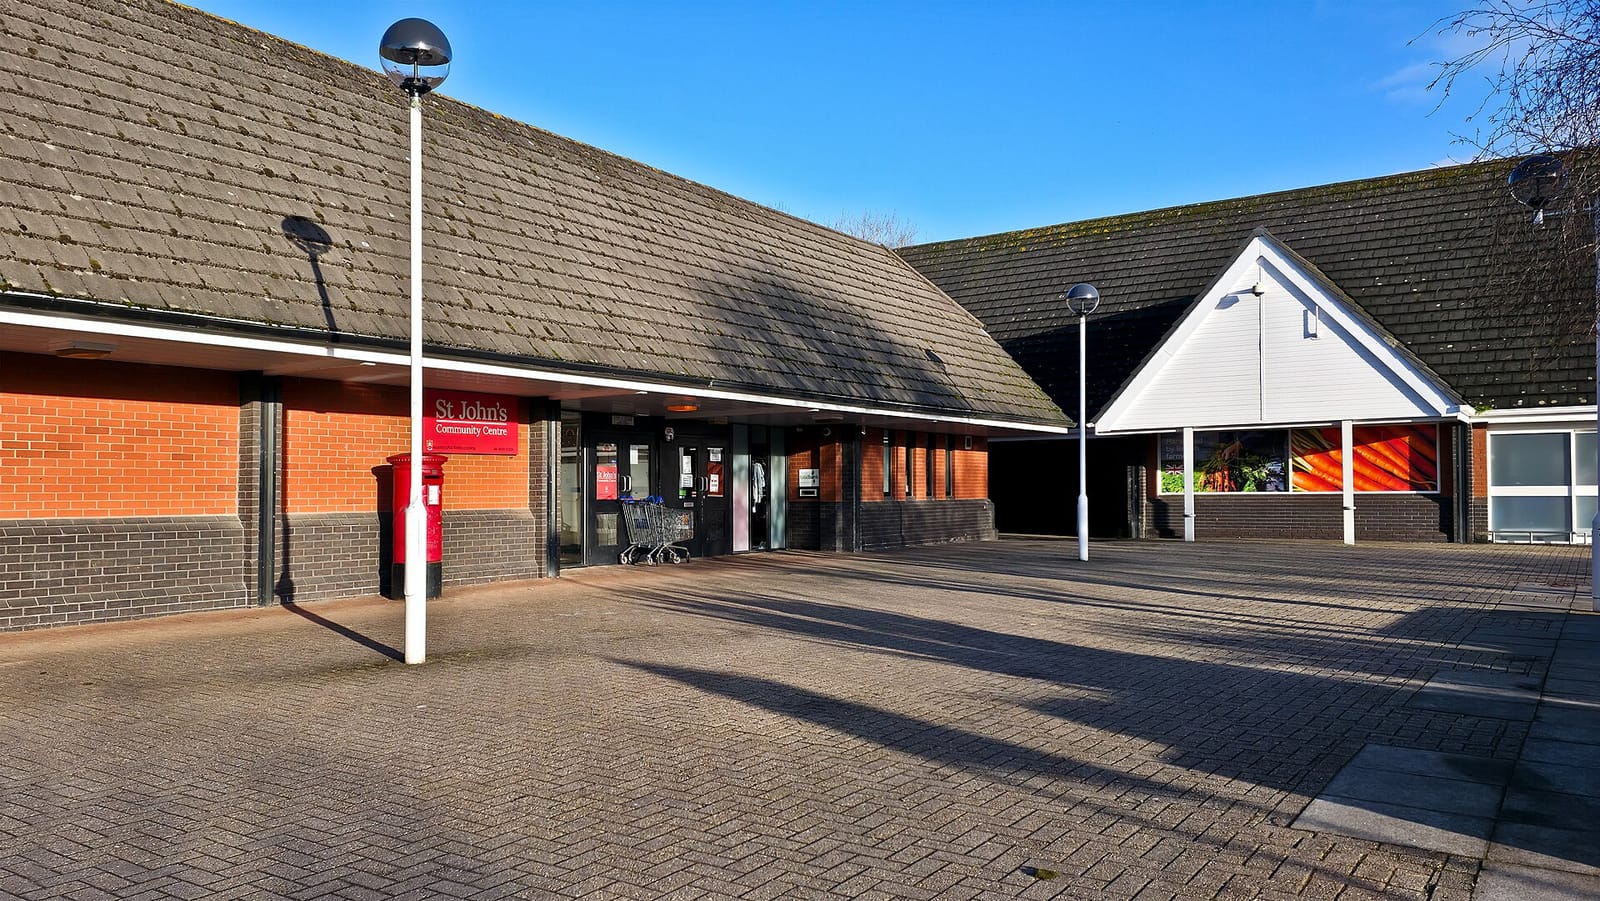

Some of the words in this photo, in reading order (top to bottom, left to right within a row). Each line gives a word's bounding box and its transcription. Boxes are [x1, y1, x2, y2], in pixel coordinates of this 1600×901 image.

[435, 399, 454, 419] St
[458, 401, 508, 421] John's
[435, 423, 481, 437] Community
[482, 425, 508, 436] Centre
